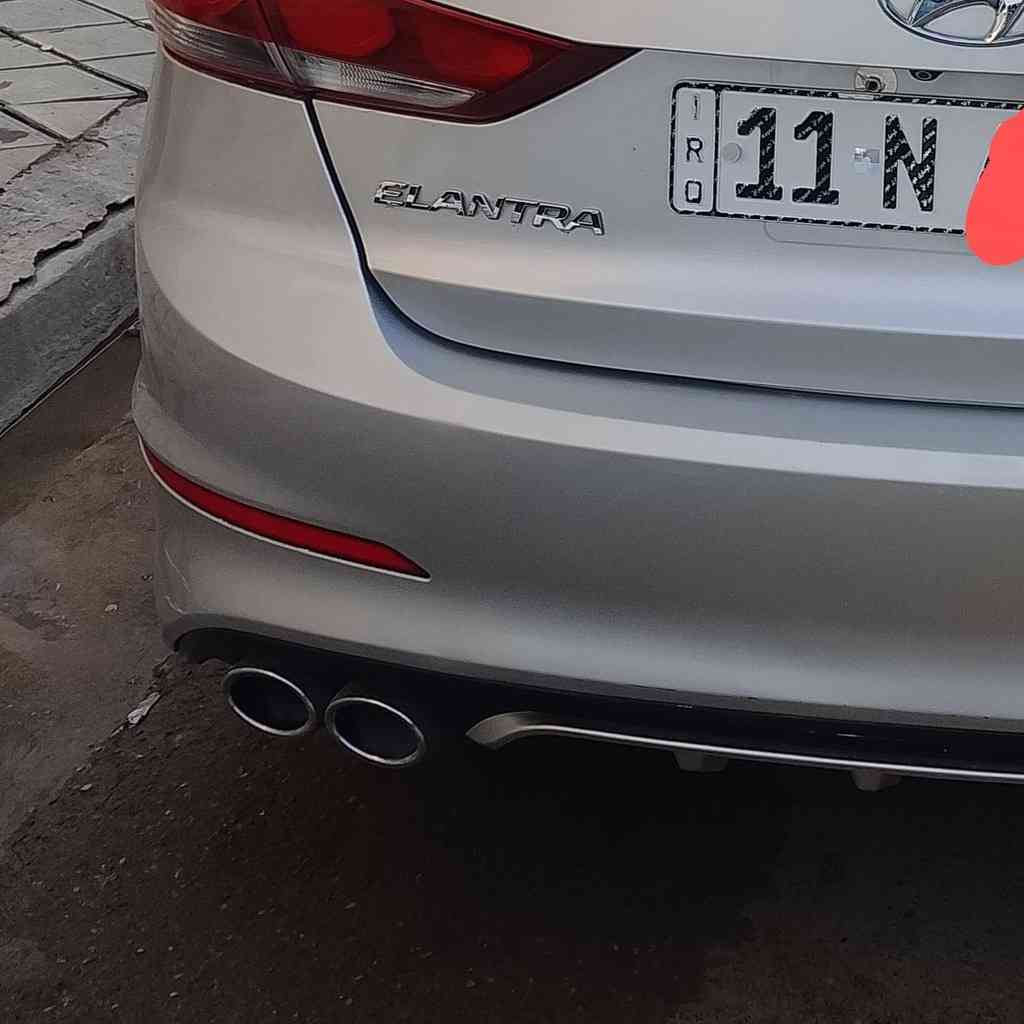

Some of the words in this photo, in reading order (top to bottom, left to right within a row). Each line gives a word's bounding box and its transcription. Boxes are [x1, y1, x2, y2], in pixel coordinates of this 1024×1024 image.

[735, 107, 839, 205] 11
[883, 115, 937, 212] N
[373, 181, 605, 235] ELANTRA
